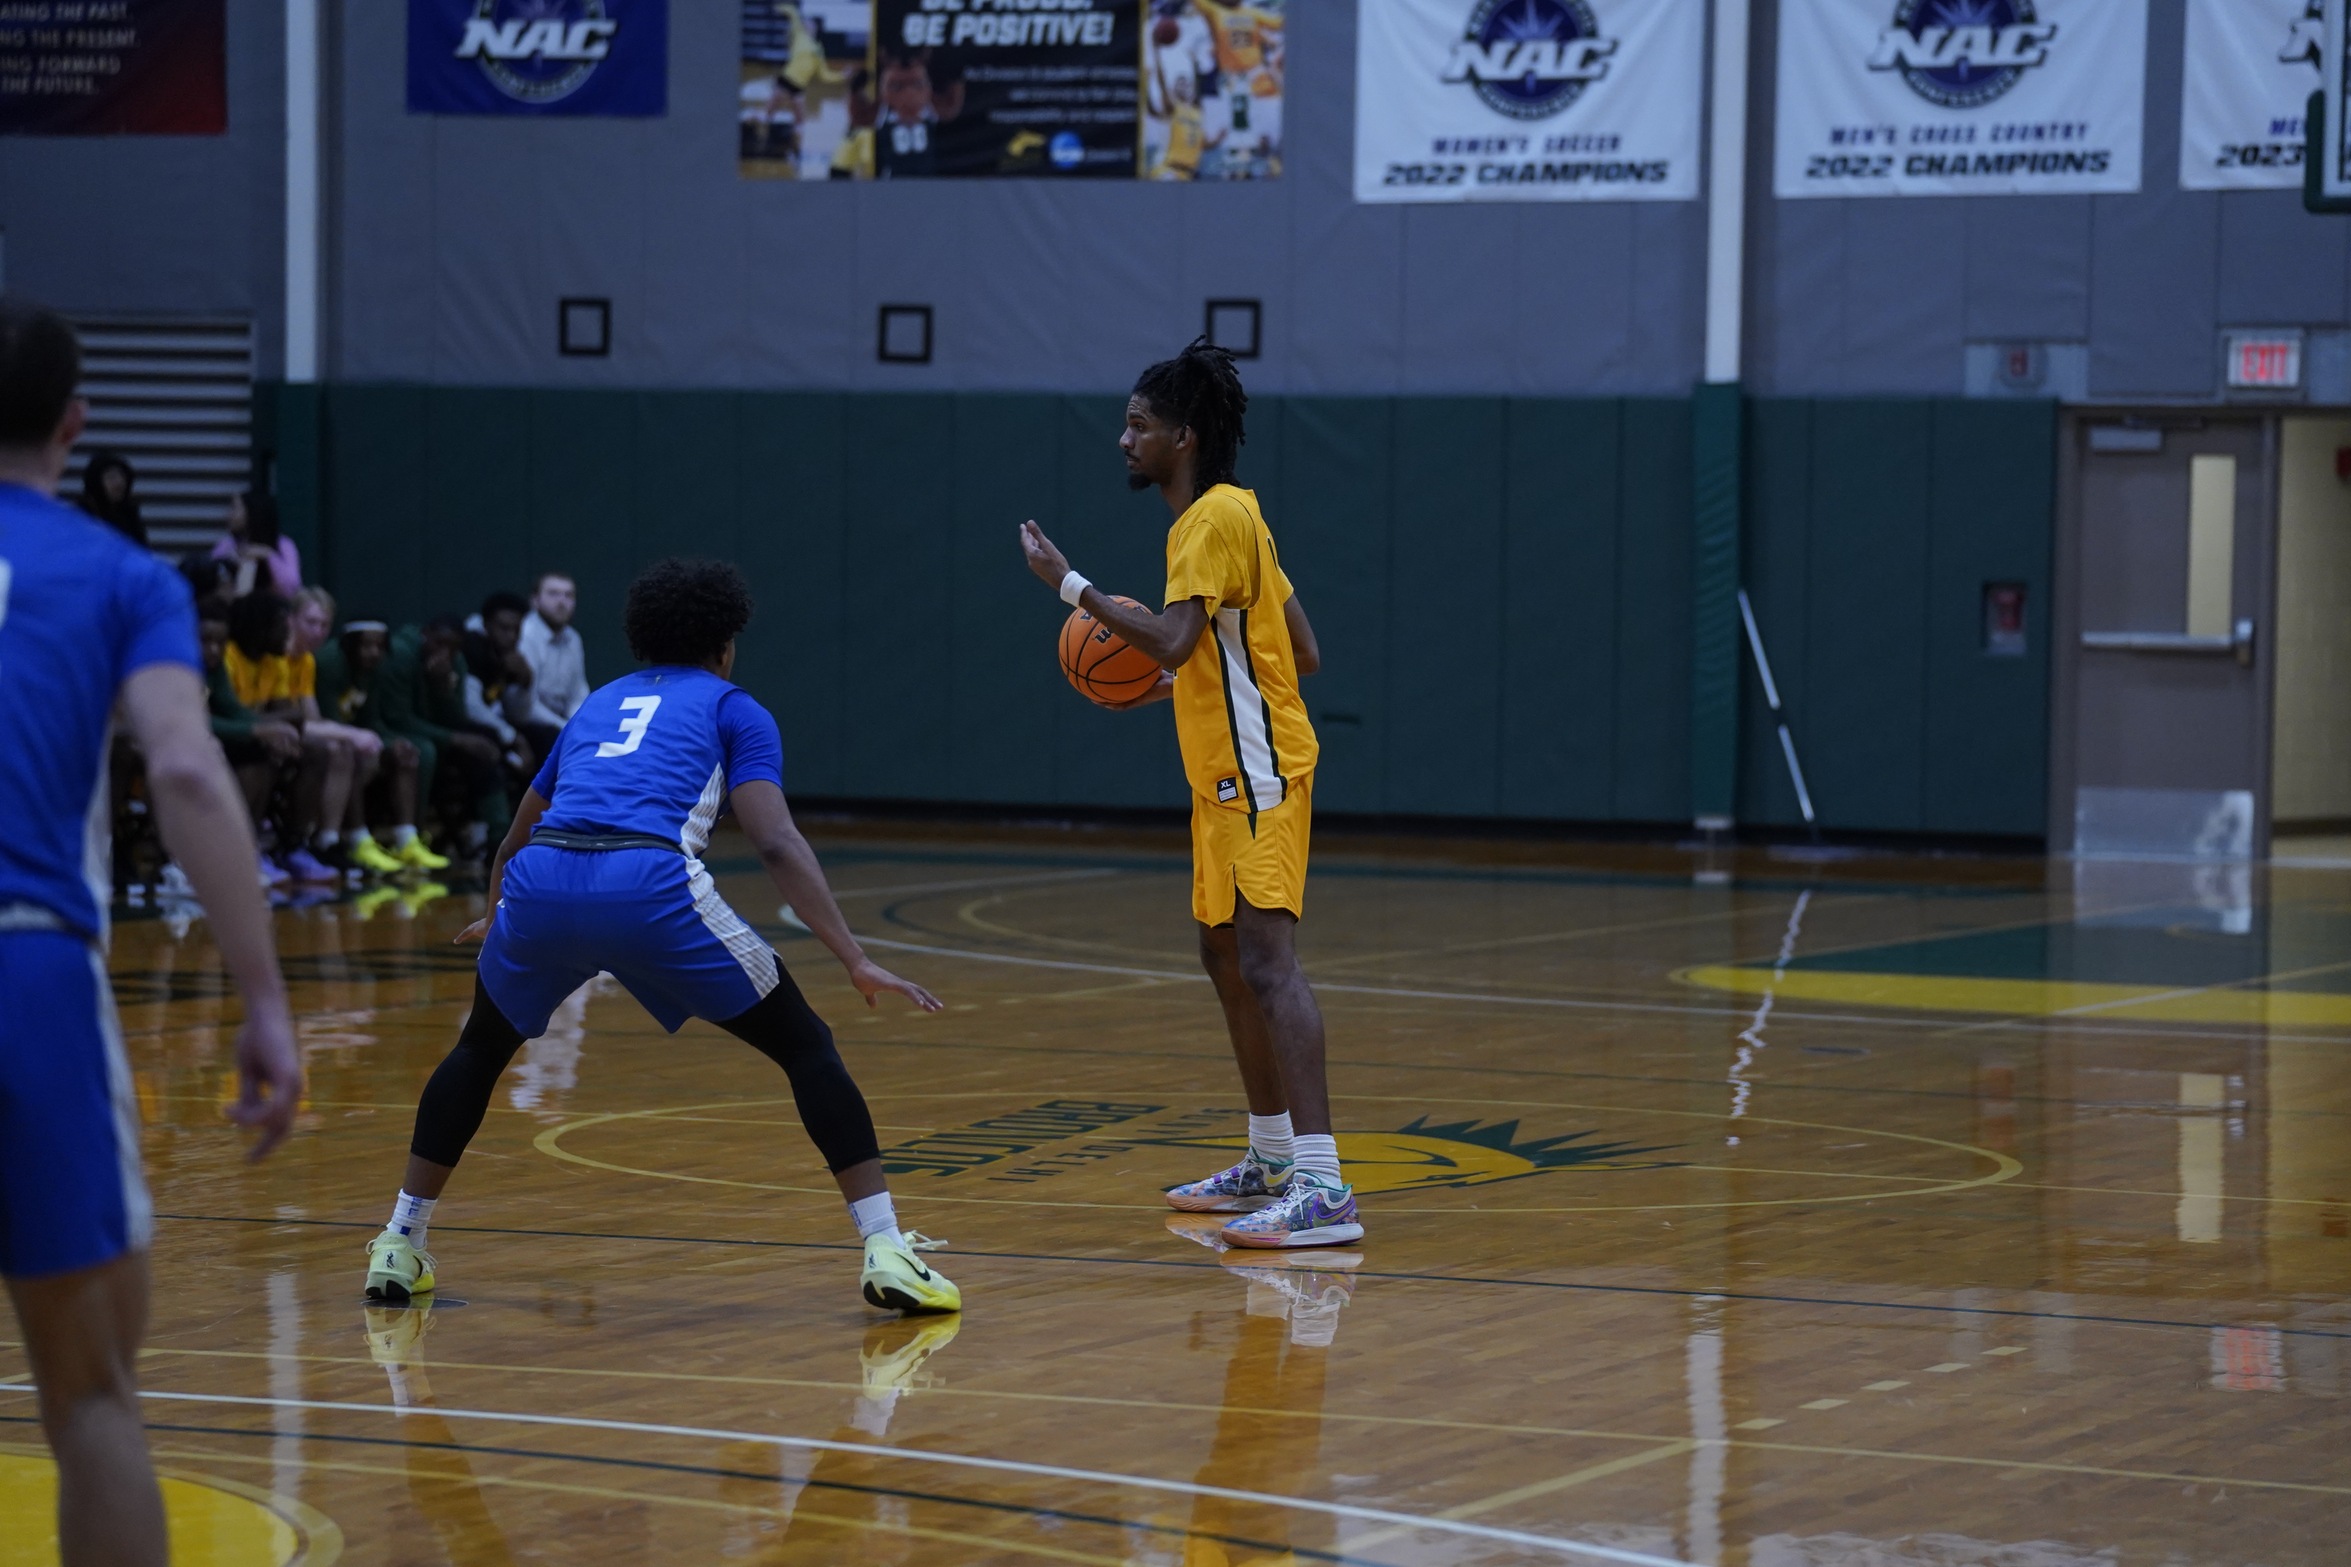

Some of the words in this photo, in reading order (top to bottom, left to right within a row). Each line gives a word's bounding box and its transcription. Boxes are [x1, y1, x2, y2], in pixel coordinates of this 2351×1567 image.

[31, 27, 60, 48] THE
[453, 17, 618, 60] NAC
[901, 11, 949, 47] BE
[952, 11, 1116, 47] POSITIVE!
[1867, 23, 2057, 70] NAC
[38, 53, 121, 75] FORWARD
[1441, 37, 1619, 82] NAC
[1991, 122, 2088, 142] COUNTRY
[1384, 163, 1465, 186] 2022
[1477, 160, 1668, 185] CHAMPIONS
[1805, 155, 1894, 179] 2022
[1904, 150, 2110, 177] CHAMPIONS
[2242, 344, 2288, 380] EXIT
[594, 695, 662, 757] 3
[1220, 780, 1231, 789] XL
[986, 1145, 1134, 1183] DELHI
